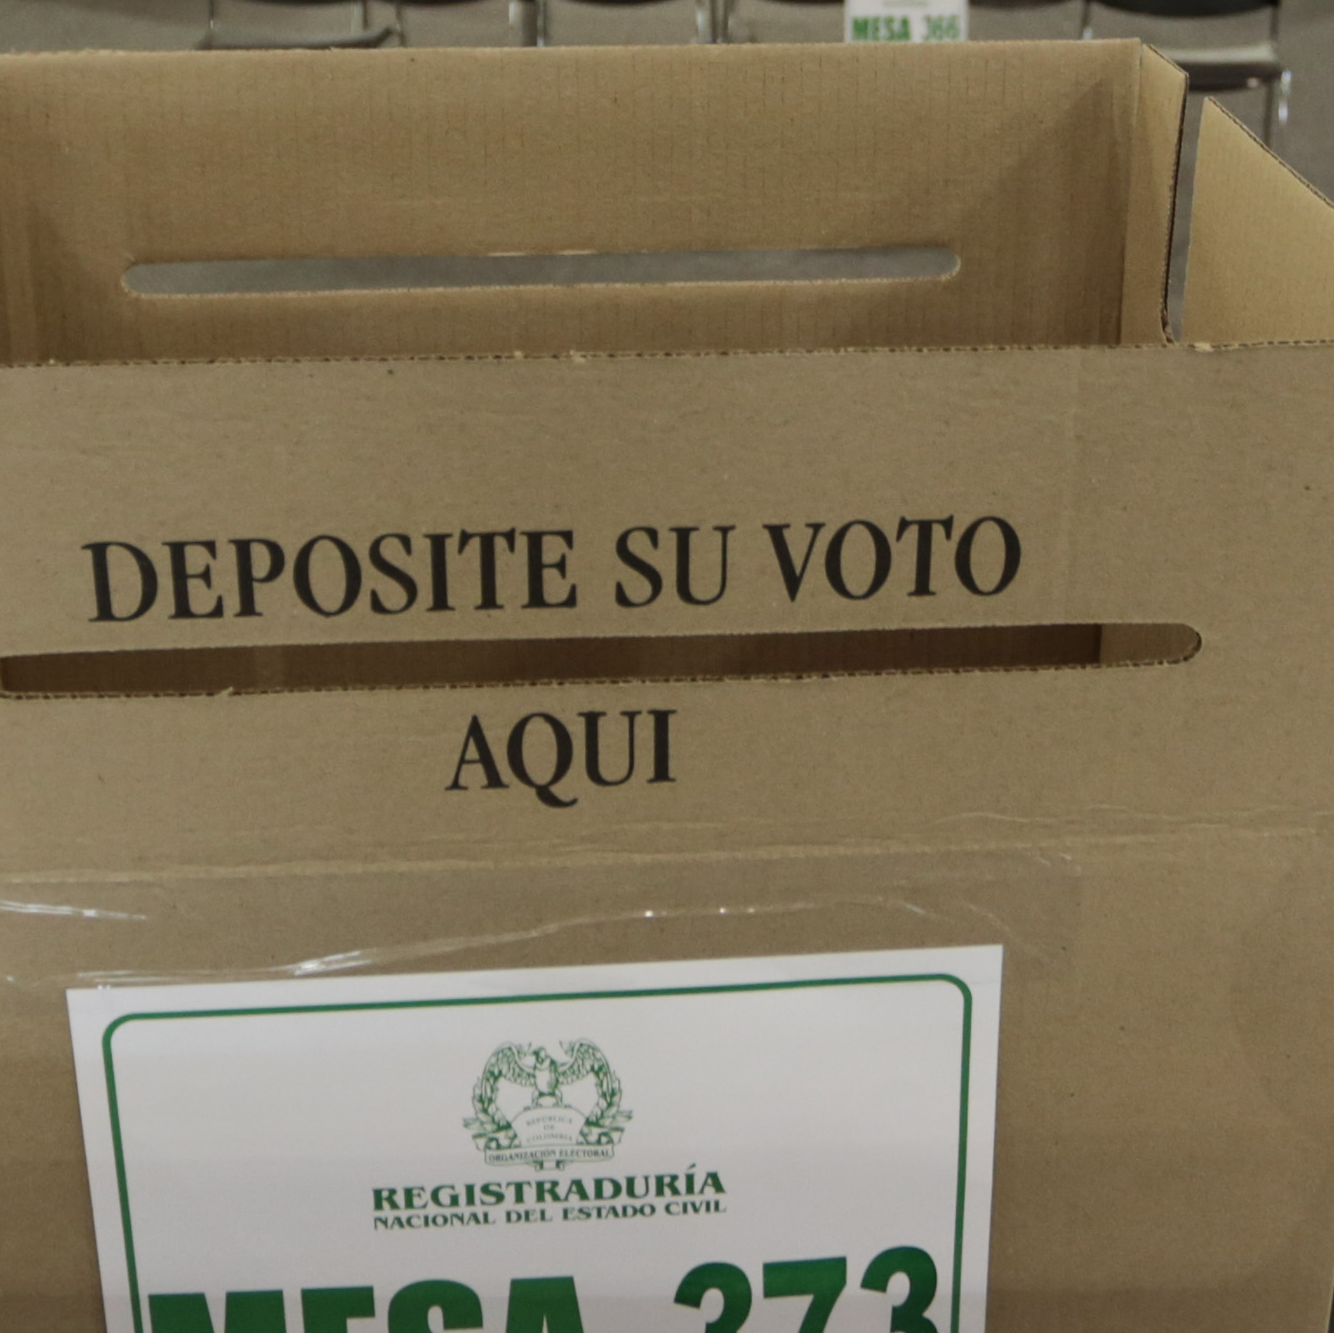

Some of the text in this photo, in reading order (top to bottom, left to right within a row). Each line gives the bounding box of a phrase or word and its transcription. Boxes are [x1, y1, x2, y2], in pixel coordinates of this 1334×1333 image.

[852, 16, 911, 42] MESA
[82, 515, 1022, 622] DEPOSITE SU VOTO
[445, 709, 676, 809] AQUI
[488, 1147, 612, 1163] ORGANIZACIÓN ELECTORAL
[372, 1163, 727, 1212] REGISTRADURÍA
[374, 1199, 727, 1231] NACIONAL DEL ESTADO CIVIL
